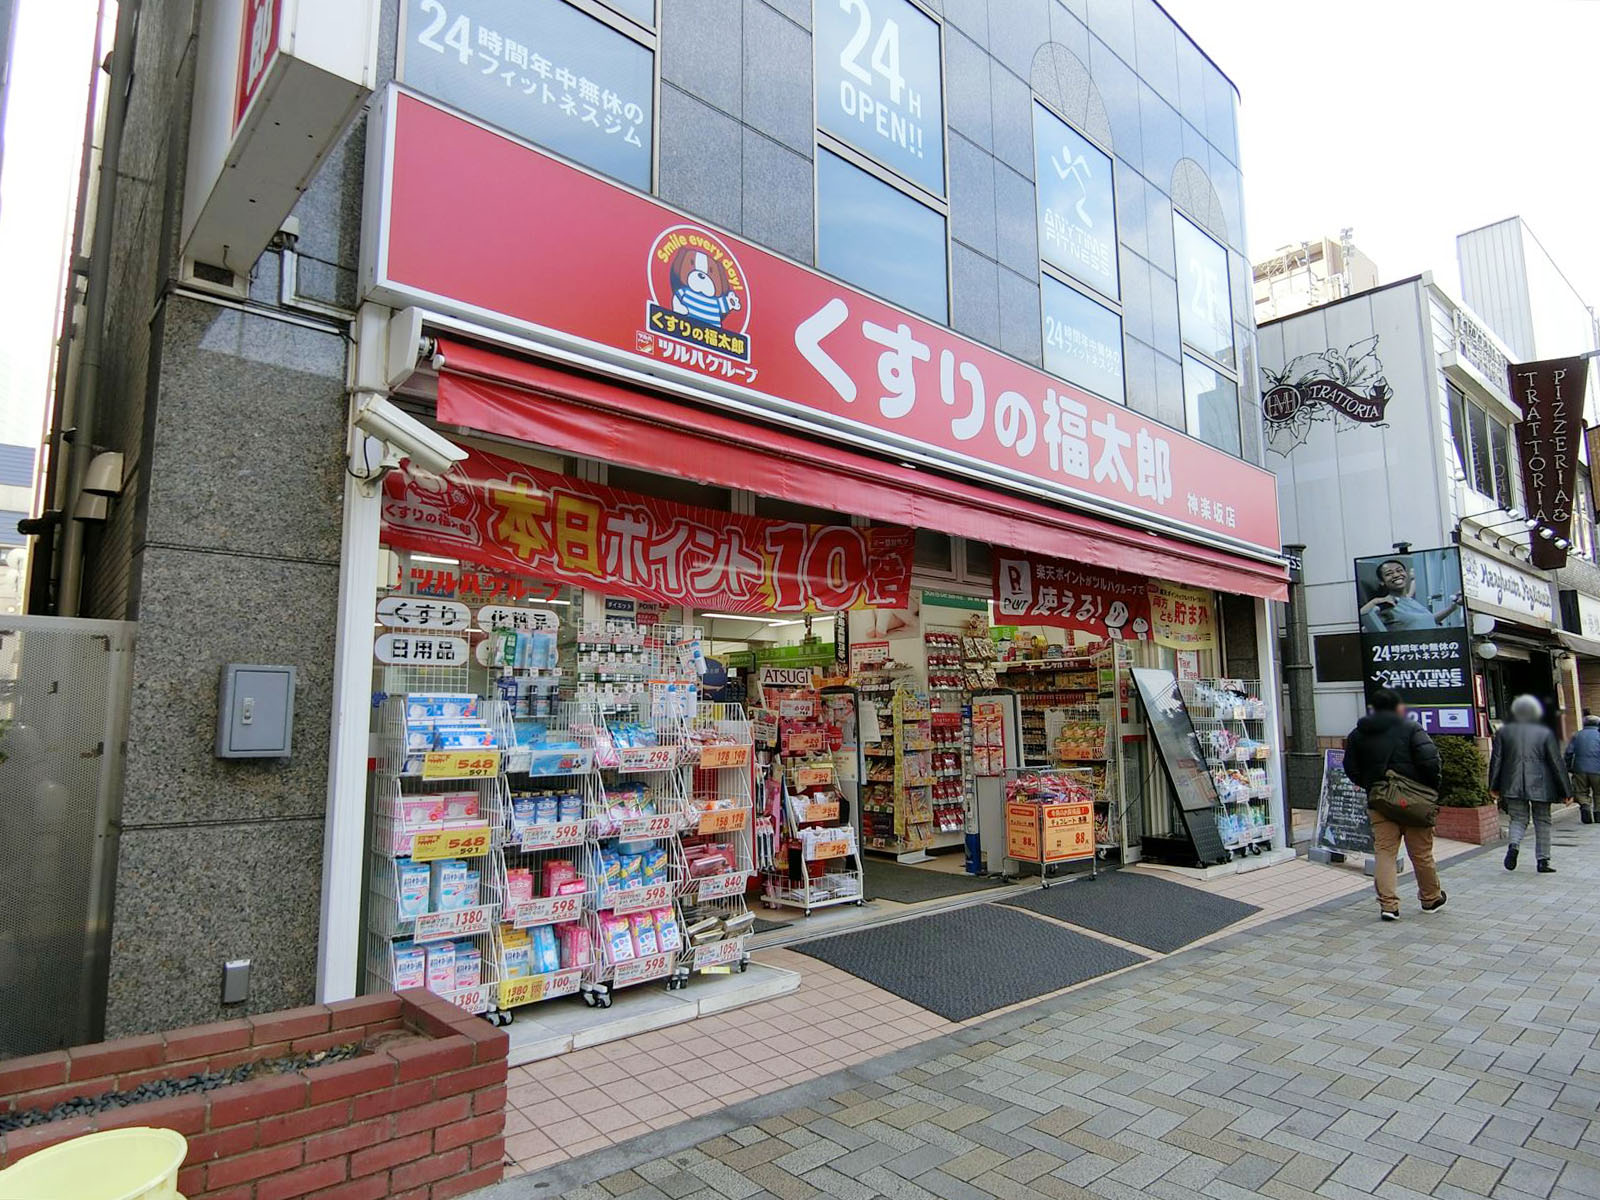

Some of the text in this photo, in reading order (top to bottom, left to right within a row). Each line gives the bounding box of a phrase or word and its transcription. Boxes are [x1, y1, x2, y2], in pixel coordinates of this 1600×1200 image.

[418, 0, 645, 126] 24 時間年中無休の
[478, 53, 643, 149] フィットネスジム
[840, 81, 924, 159] OPEN!!
[1044, 208, 1110, 259] ANYTIME
[1046, 227, 1111, 277] FITNESS
[657, 234, 744, 291] Smile every day!
[652, 311, 745, 355] くすりの福太郎
[1046, 316, 1064, 349] 24
[658, 338, 758, 383] ツルハグループ
[795, 298, 1172, 505] くすりの福太郎
[1310, 385, 1379, 418] TRATTORIA
[1517, 371, 1549, 523] TRATTORIA
[1187, 492, 1236, 529] 神楽坂店
[395, 602, 457, 626] くすり
[392, 639, 455, 660] 日用品
[1372, 645, 1391, 662] 24
[1391, 650, 1460, 661] フィットネスジム
[764, 669, 809, 684] ATSUGI
[1390, 668, 1462, 680] ANYTIME
[1391, 679, 1462, 688] FITNESS
[457, 759, 494, 769] 548
[649, 751, 669, 763] 298
[650, 817, 670, 830] 228
[556, 825, 578, 839] 598
[1075, 832, 1085, 844] 88
[448, 837, 485, 849] 548
[460, 847, 479, 855] 591
[724, 876, 741, 887] 840
[645, 887, 666, 900] 598
[551, 899, 575, 914] 598
[456, 910, 483, 926] 1380
[644, 957, 665, 971] 598
[507, 985, 528, 998] 1380
